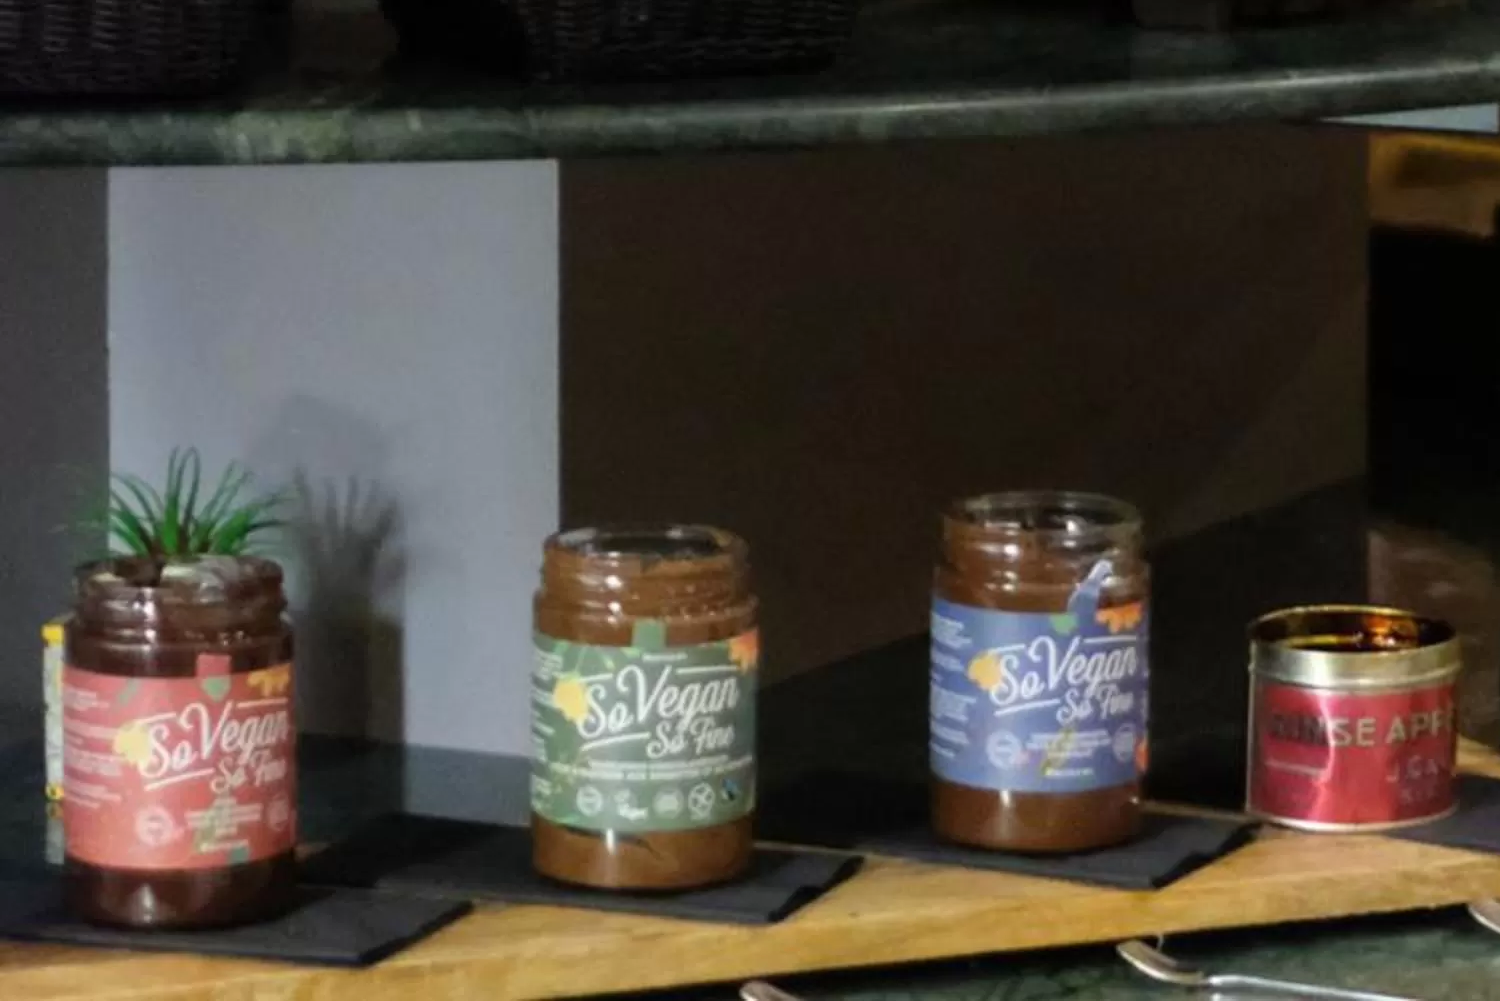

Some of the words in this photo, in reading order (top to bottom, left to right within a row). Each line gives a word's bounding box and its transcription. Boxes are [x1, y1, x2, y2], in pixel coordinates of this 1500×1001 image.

[576, 683, 634, 739] So
[616, 664, 740, 730] Vegan
[990, 653, 1046, 706] So
[1028, 635, 1137, 697] Vegan
[138, 723, 196, 778] So
[179, 701, 288, 765] Vegan
